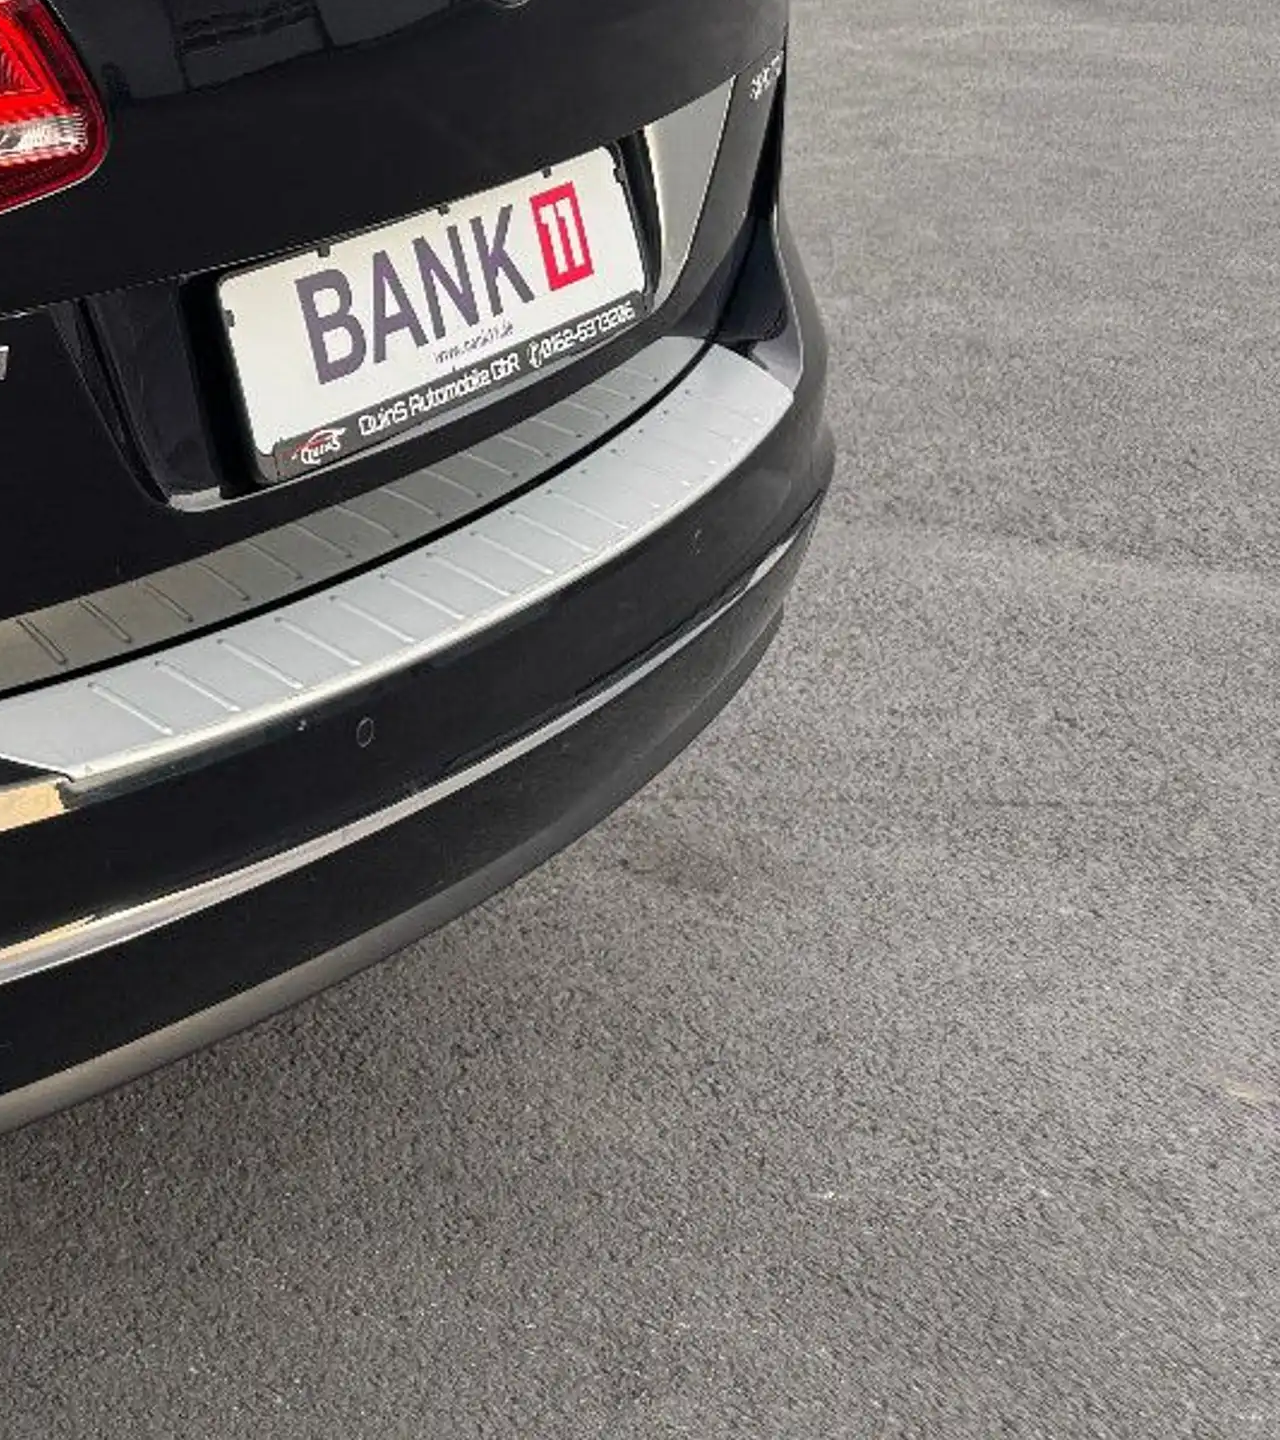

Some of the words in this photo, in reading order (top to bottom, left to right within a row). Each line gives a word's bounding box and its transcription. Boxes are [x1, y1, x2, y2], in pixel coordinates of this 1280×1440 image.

[294, 204, 535, 385] BANK
[538, 194, 588, 278] 11
[408, 368, 492, 417] Automobile
